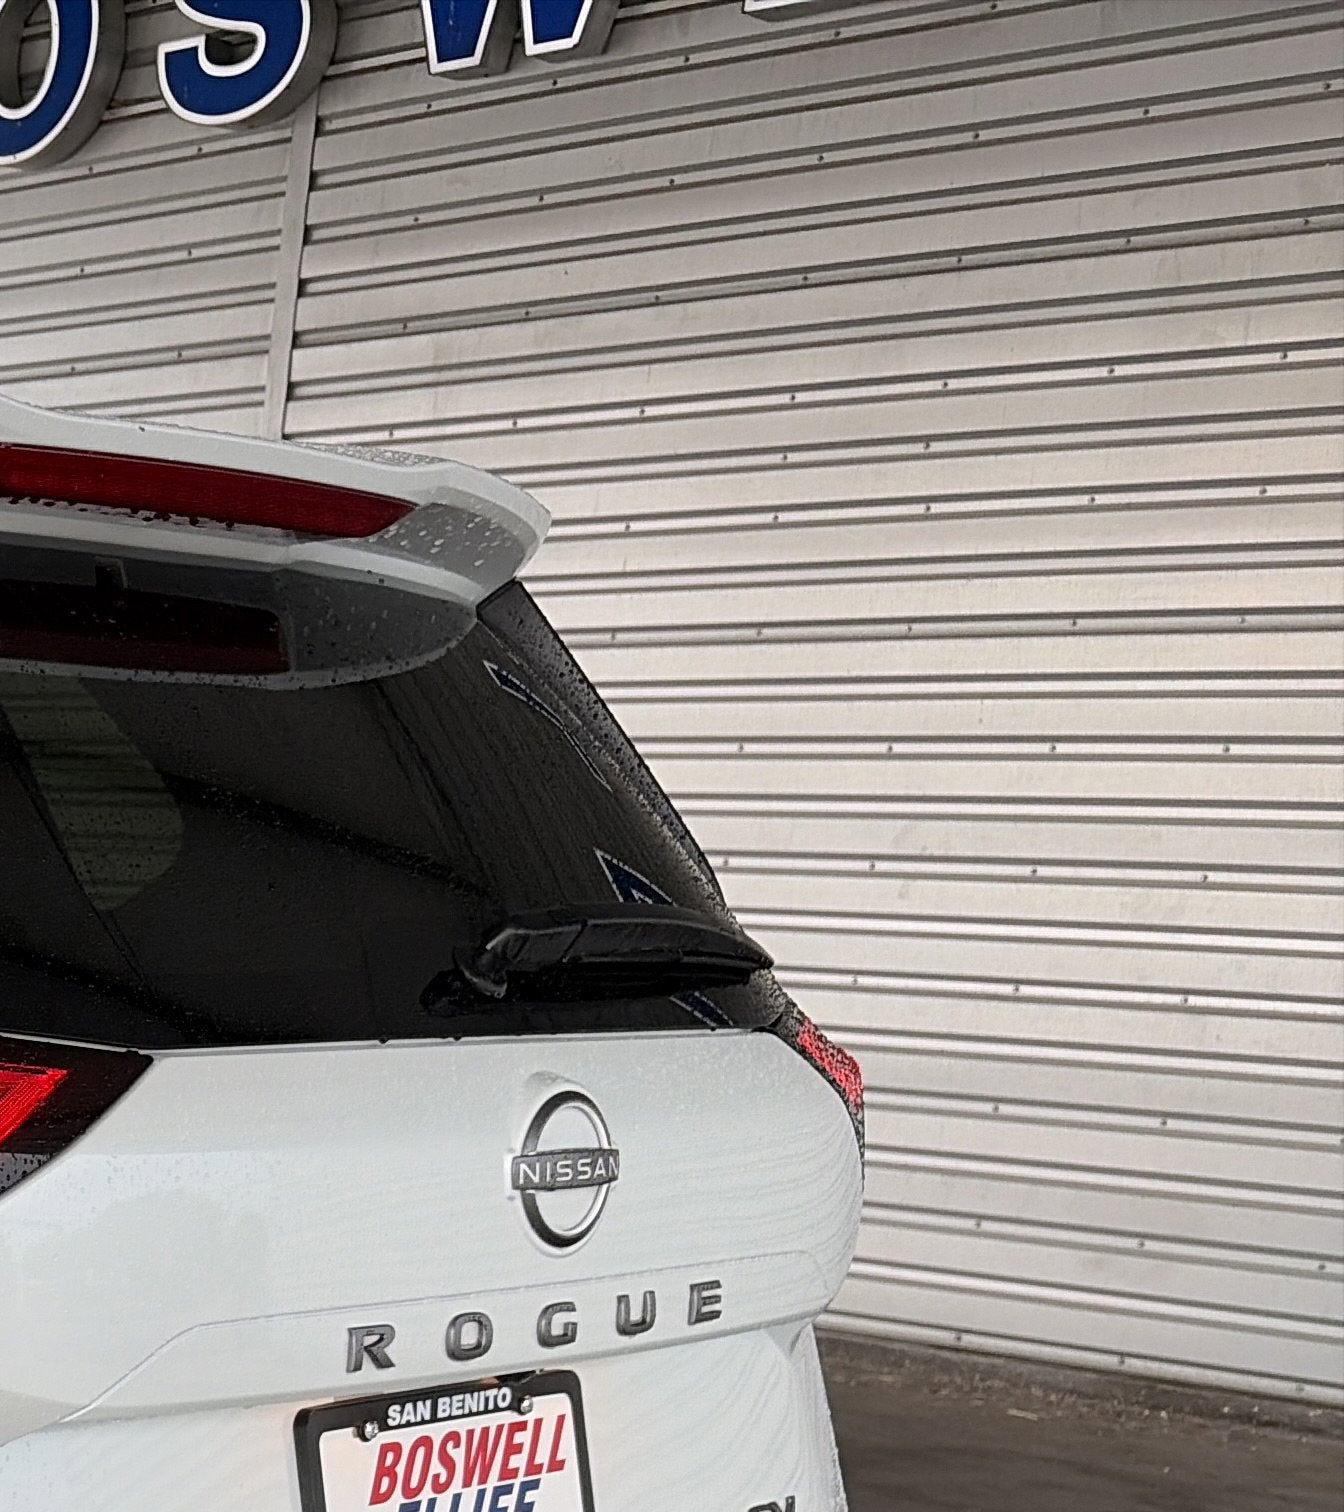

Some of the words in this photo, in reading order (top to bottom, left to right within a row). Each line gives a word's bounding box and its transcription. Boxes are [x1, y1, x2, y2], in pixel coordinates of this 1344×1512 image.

[518, 1155, 619, 1185] NISSAN
[345, 1279, 723, 1374] ROGUE
[386, 1400, 431, 1426] SAN
[436, 1387, 512, 1419] BENITO
[368, 1414, 566, 1506] BOSWELL
